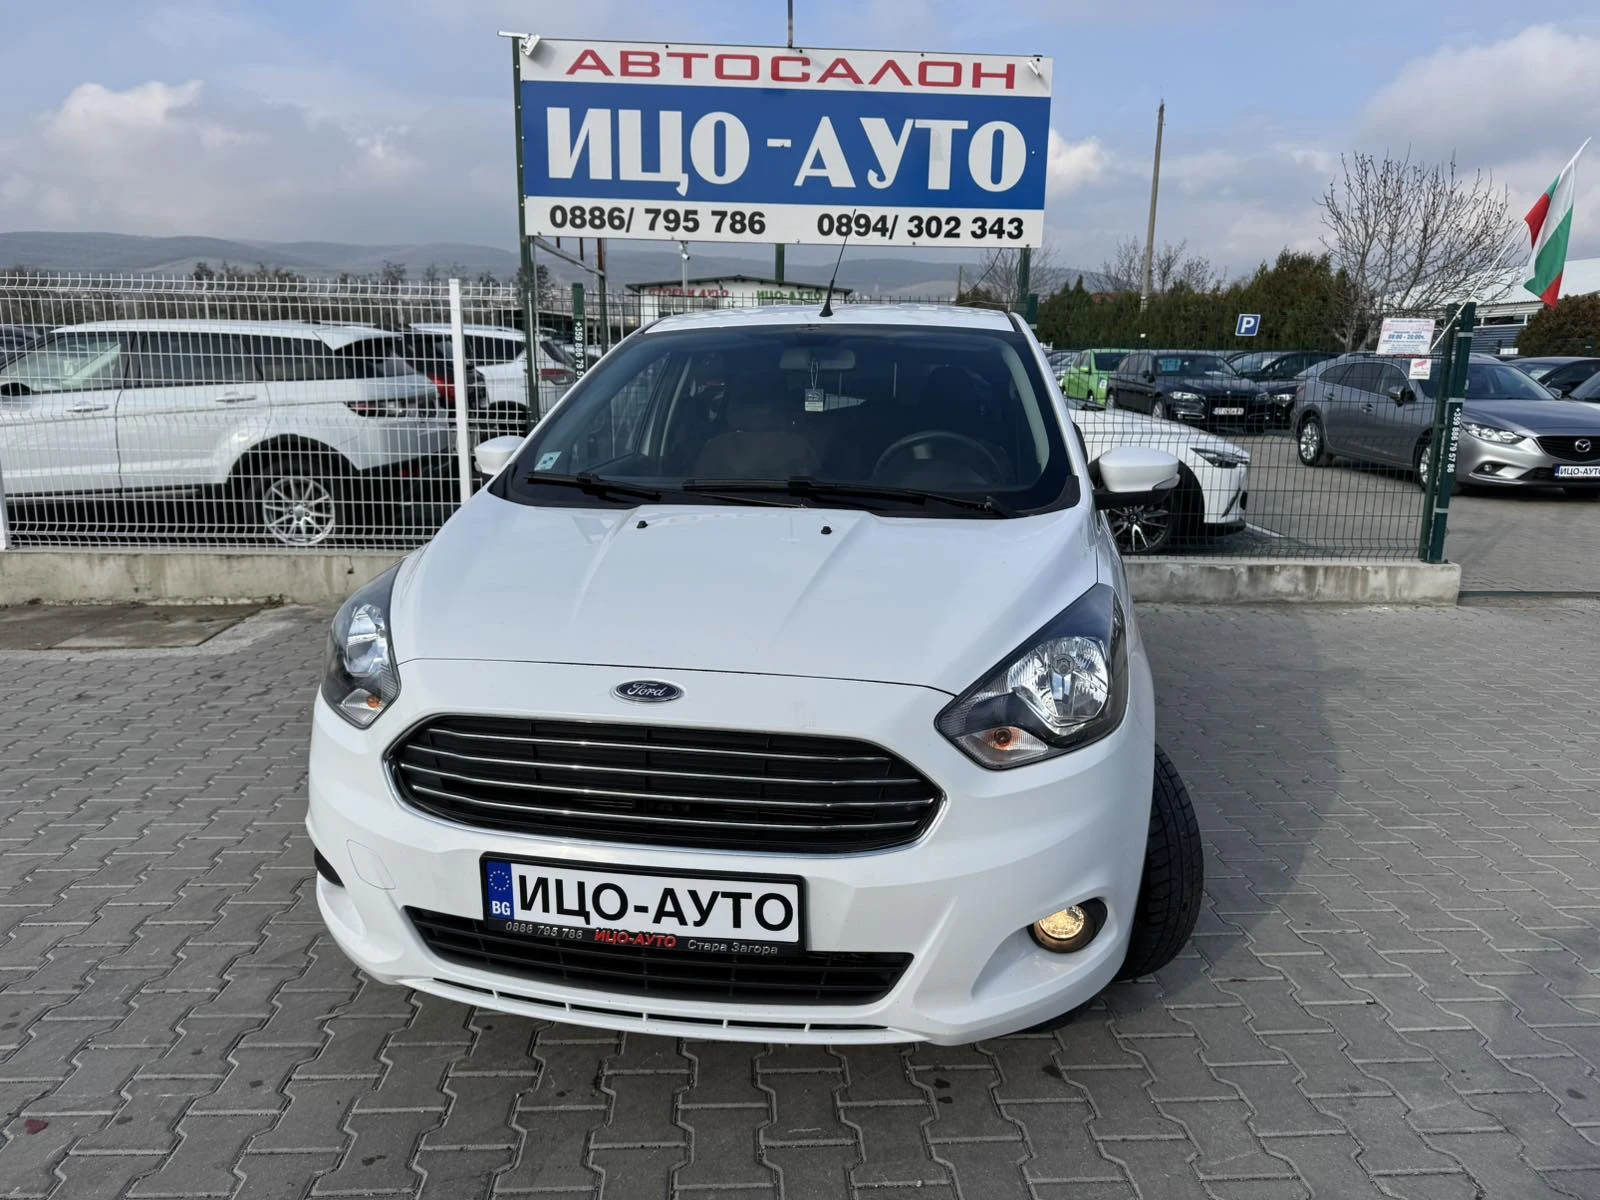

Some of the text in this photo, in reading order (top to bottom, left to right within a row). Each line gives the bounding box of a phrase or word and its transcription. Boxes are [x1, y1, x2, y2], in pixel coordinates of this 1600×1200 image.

[565, 49, 1016, 89] АВТОСАЛОН
[549, 204, 766, 234] 0886/ 795 786
[907, 215, 961, 238] 302
[970, 217, 1023, 239] 343
[1560, 467, 1600, 475] ИЦО-АУТ
[627, 682, 667, 696] Ford
[492, 901, 511, 916] BG
[518, 874, 794, 931] ИЦО-АУТО
[505, 921, 778, 956] 0886 795 786 ИЦО-АУТО Стара Загора
